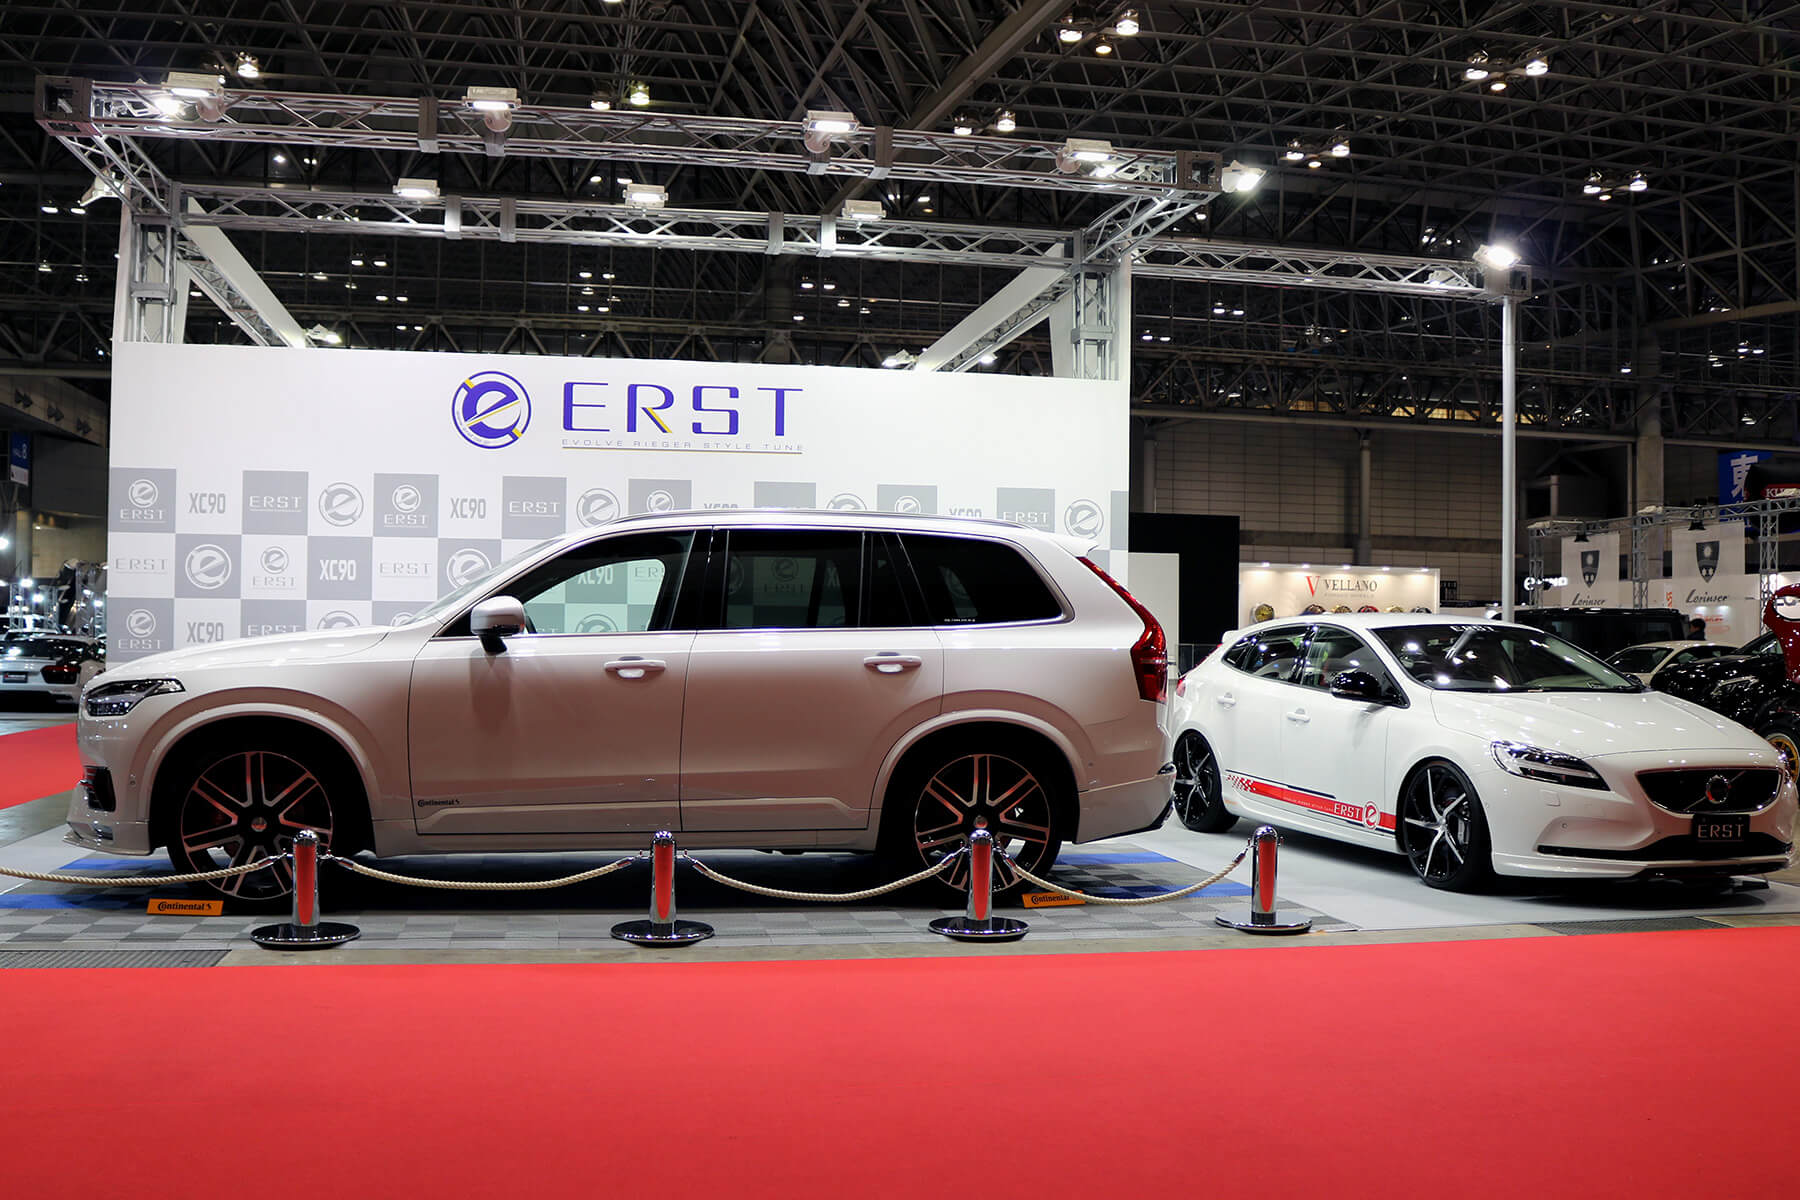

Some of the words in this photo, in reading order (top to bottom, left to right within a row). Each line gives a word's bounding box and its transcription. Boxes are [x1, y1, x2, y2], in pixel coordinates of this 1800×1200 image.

[562, 381, 804, 437] ERST
[561, 438, 623, 447] EVOLVE
[633, 440, 691, 449] RIEGER
[703, 441, 751, 450] STYLE
[764, 443, 803, 451] TUNE
[189, 493, 226, 514] XC90
[249, 496, 302, 508] ERST
[450, 498, 487, 519] XC90
[509, 501, 560, 513] ERST
[120, 508, 165, 520] ERST
[384, 514, 429, 525] ERST
[1002, 511, 1050, 523] ERST
[115, 558, 169, 570] ERST
[319, 559, 357, 581] XC90
[379, 562, 433, 575] ERST
[252, 576, 297, 587] ERST
[577, 566, 614, 585] XC90
[1324, 578, 1378, 592] VELLANO
[1685, 588, 1728, 604] Lorinser
[187, 622, 224, 643] XC90
[247, 624, 302, 636] ERST
[118, 639, 166, 650] ERST
[1333, 803, 1362, 820] ERST
[1697, 823, 1744, 839] ERST
[157, 901, 205, 911] Continental
